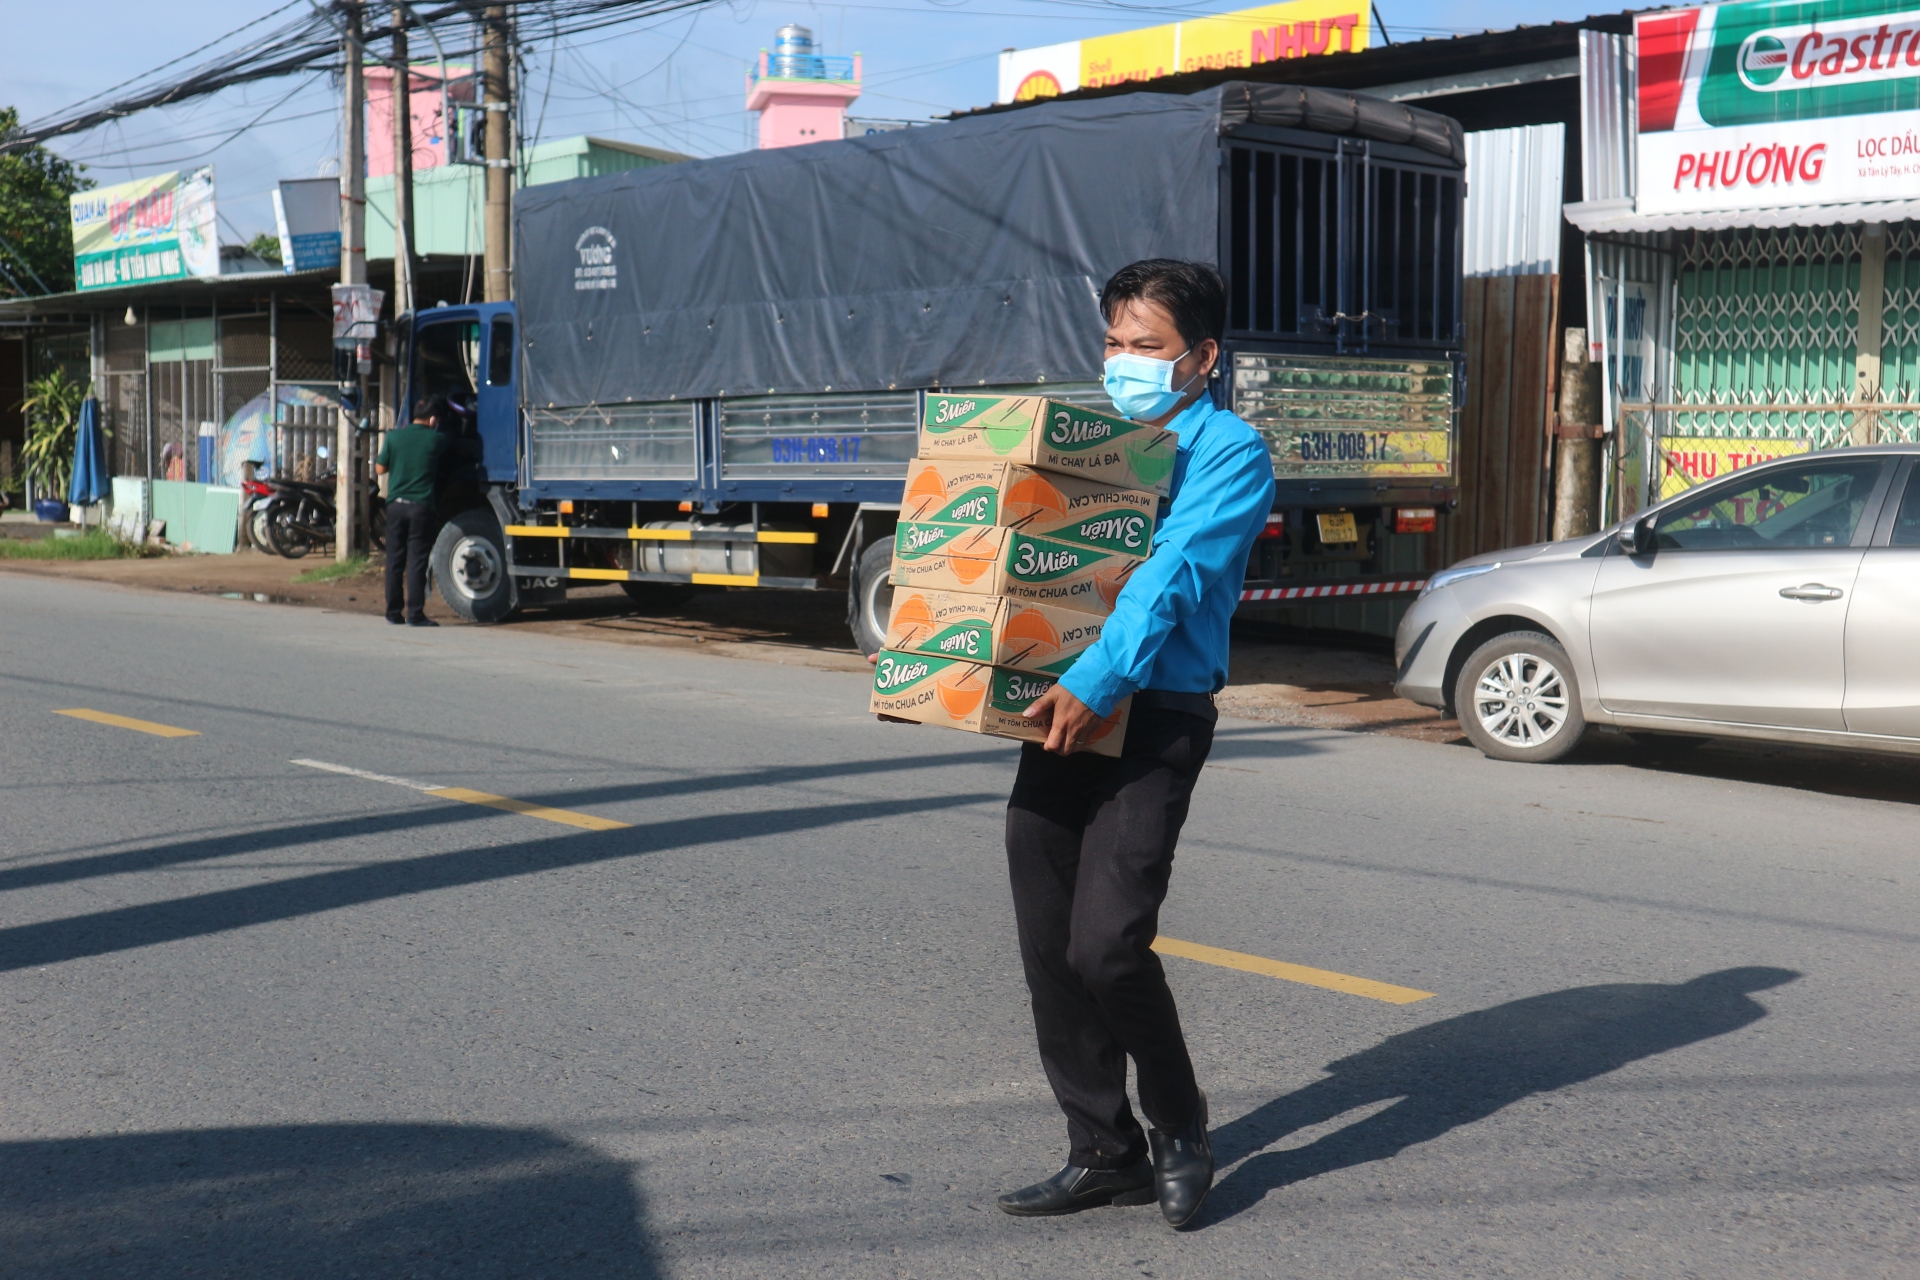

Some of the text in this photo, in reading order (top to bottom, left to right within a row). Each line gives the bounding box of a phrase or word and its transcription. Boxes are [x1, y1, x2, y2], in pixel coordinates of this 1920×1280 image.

[1089, 58, 1113, 75] Shell
[1184, 50, 1244, 73] GARAGE
[1857, 137, 1887, 163] LỌC
[1673, 142, 1827, 190] PHƯƠNG
[941, 439, 957, 447] CHAY
[958, 435, 966, 445] LÁ
[967, 432, 978, 443] ĐA
[1301, 432, 1388, 461] 63H-009.17
[1048, 452, 1120, 467] MÌ CHAY LÁ ĐA
[947, 477, 959, 490] CAY
[959, 473, 975, 482] CHUA
[1068, 493, 1151, 510] MÌ TÔM CHUA CAY
[917, 563, 933, 574] CHUA
[933, 558, 947, 571] CAY
[521, 576, 559, 590] JAC
[1007, 581, 1093, 598] MÌ TÔM CHUA CAY
[934, 608, 947, 620] CAY
[949, 605, 966, 614] CHUA
[1062, 624, 1105, 643] HUA CAY
[881, 701, 894, 710] TÔM
[895, 699, 917, 710] CHUA
[918, 689, 935, 705] CAY
[1007, 718, 1021, 727] TÔM
[1022, 720, 1043, 728] CHUA
